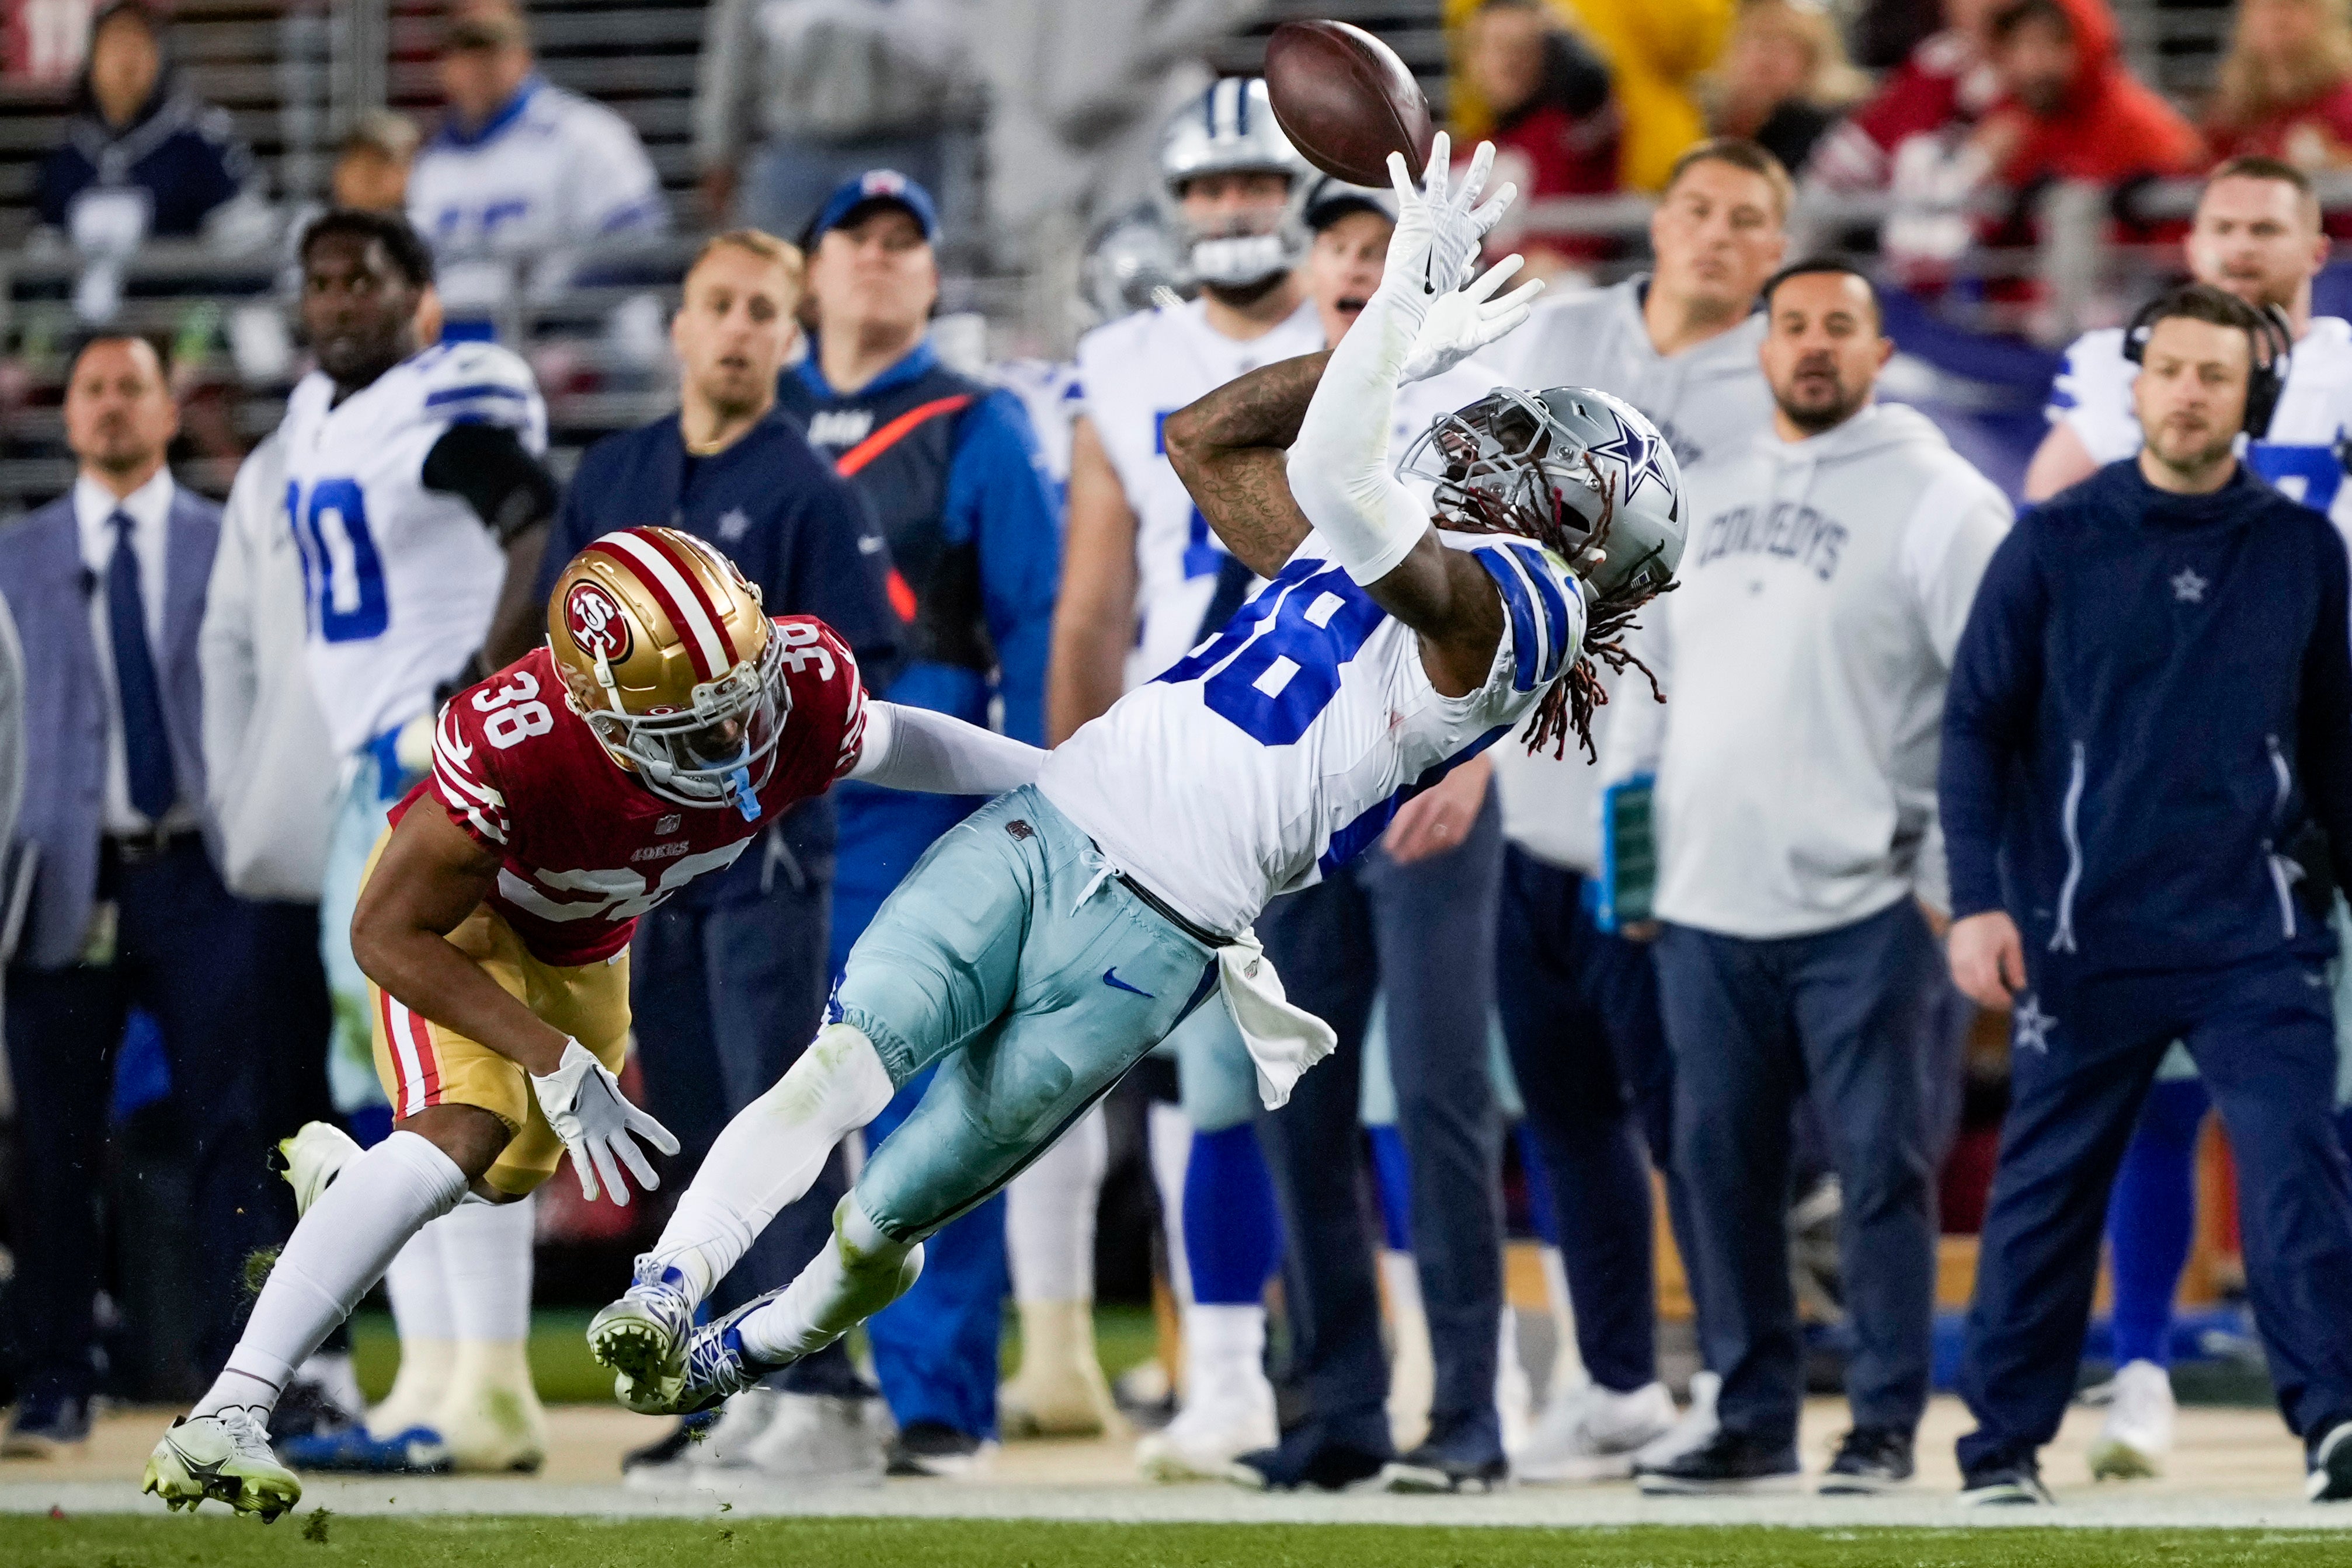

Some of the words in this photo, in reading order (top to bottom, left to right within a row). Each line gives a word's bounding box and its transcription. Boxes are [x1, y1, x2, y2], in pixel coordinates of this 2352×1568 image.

[1143, 558, 1387, 747] 88
[471, 670, 554, 750] 38
[629, 840, 690, 862] 49ERS
